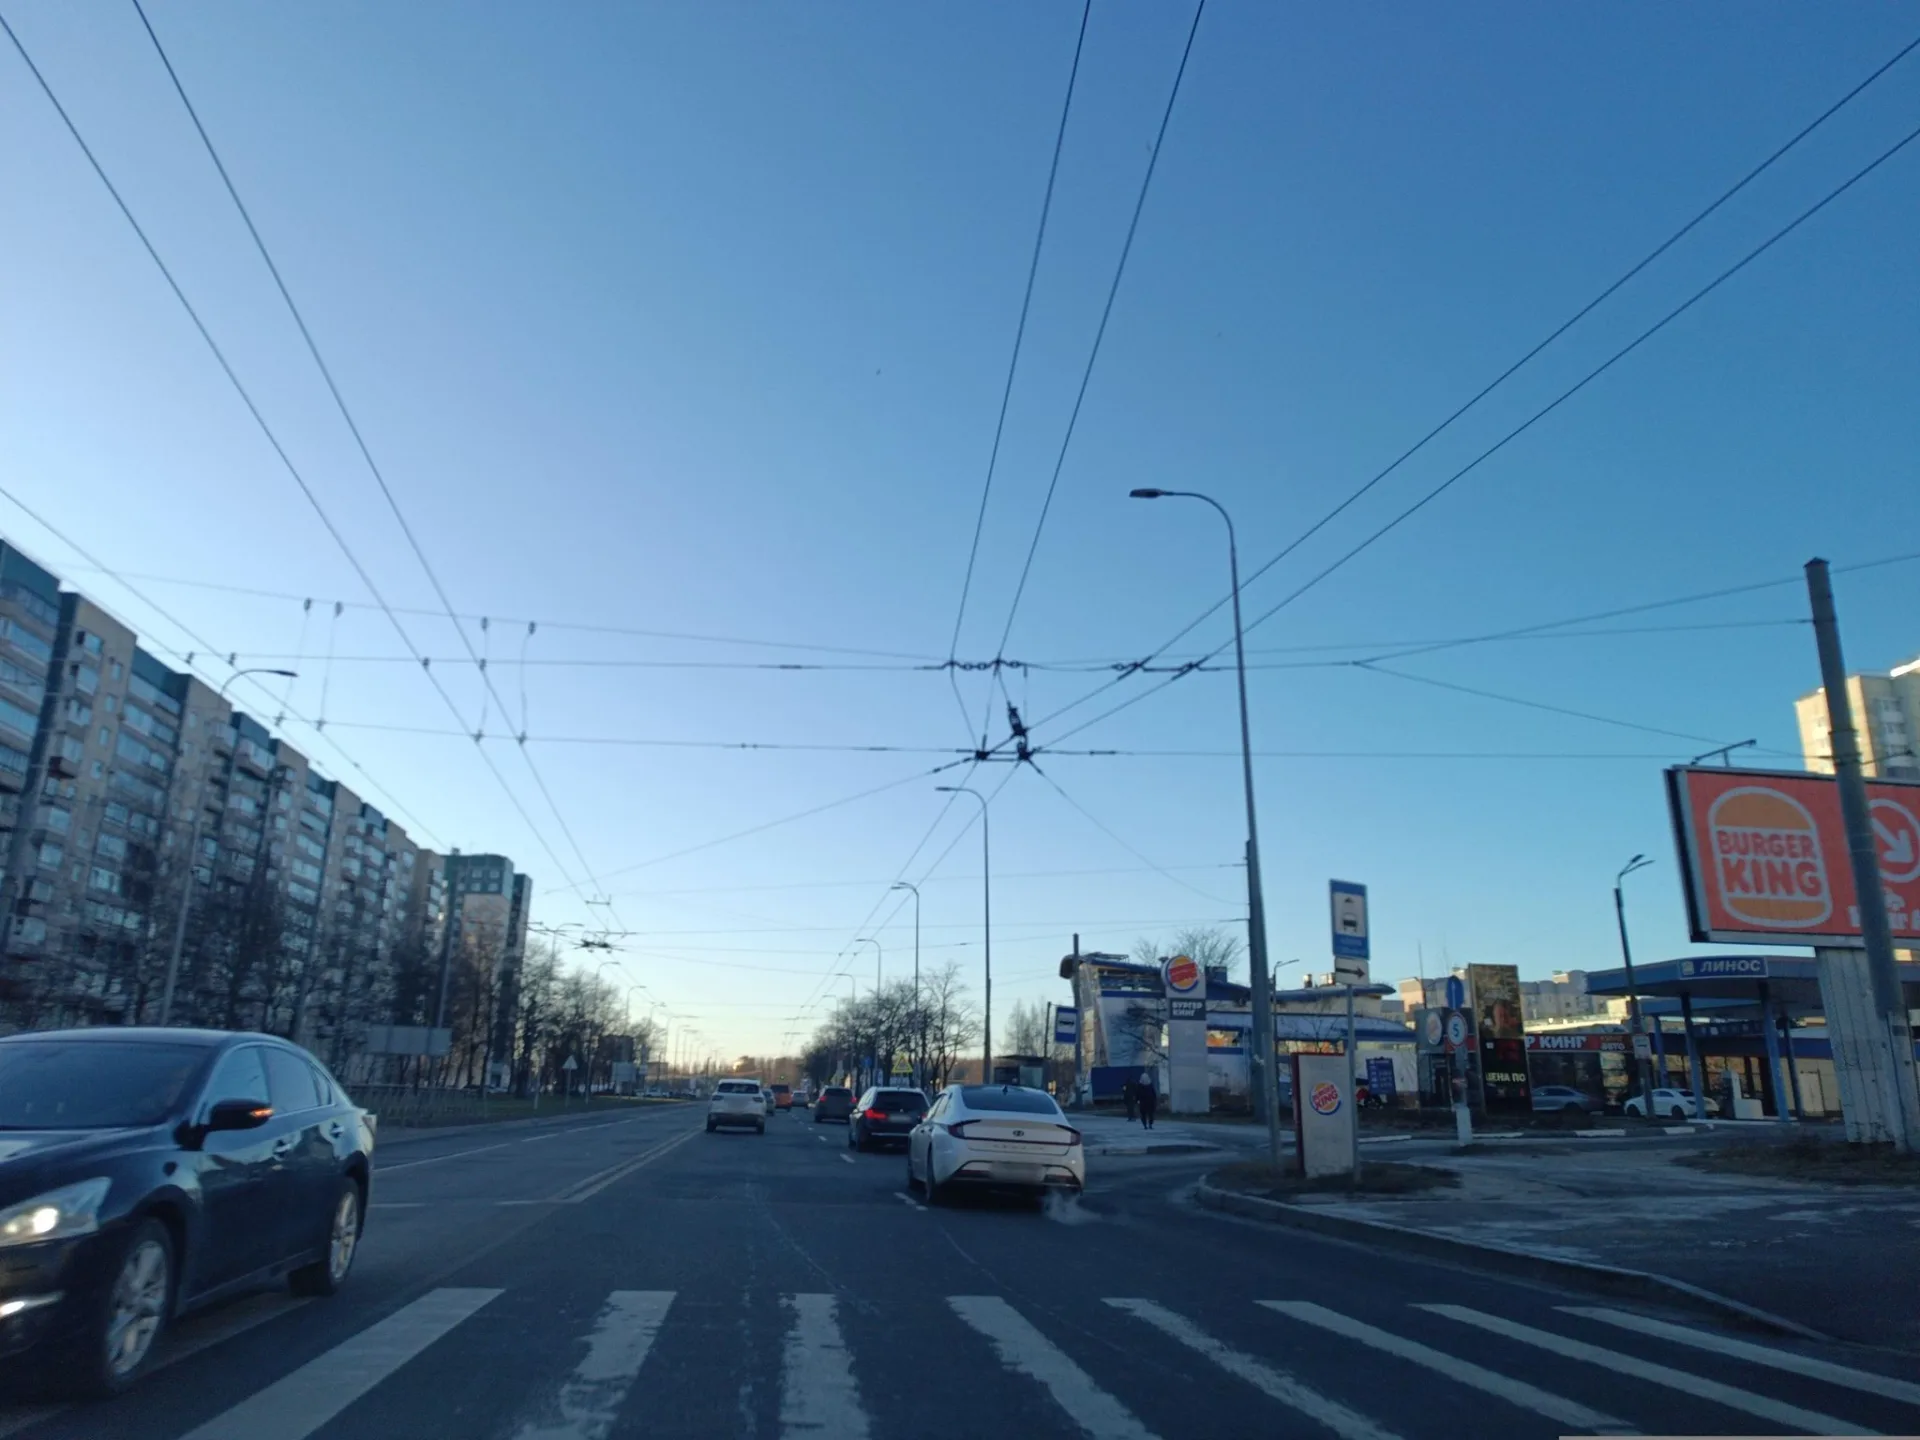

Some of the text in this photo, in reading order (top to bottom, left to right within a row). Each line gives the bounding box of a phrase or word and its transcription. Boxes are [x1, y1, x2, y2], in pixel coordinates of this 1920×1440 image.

[1717, 830, 1816, 860] BURGER
[1722, 857, 1822, 897] KING
[1700, 959, 1761, 973] ЛИНОС
[1452, 1023, 1460, 1038] 5
[1540, 1035, 1587, 1049] КИНГ
[1485, 1072, 1526, 1082] ЦЕНА ПО
